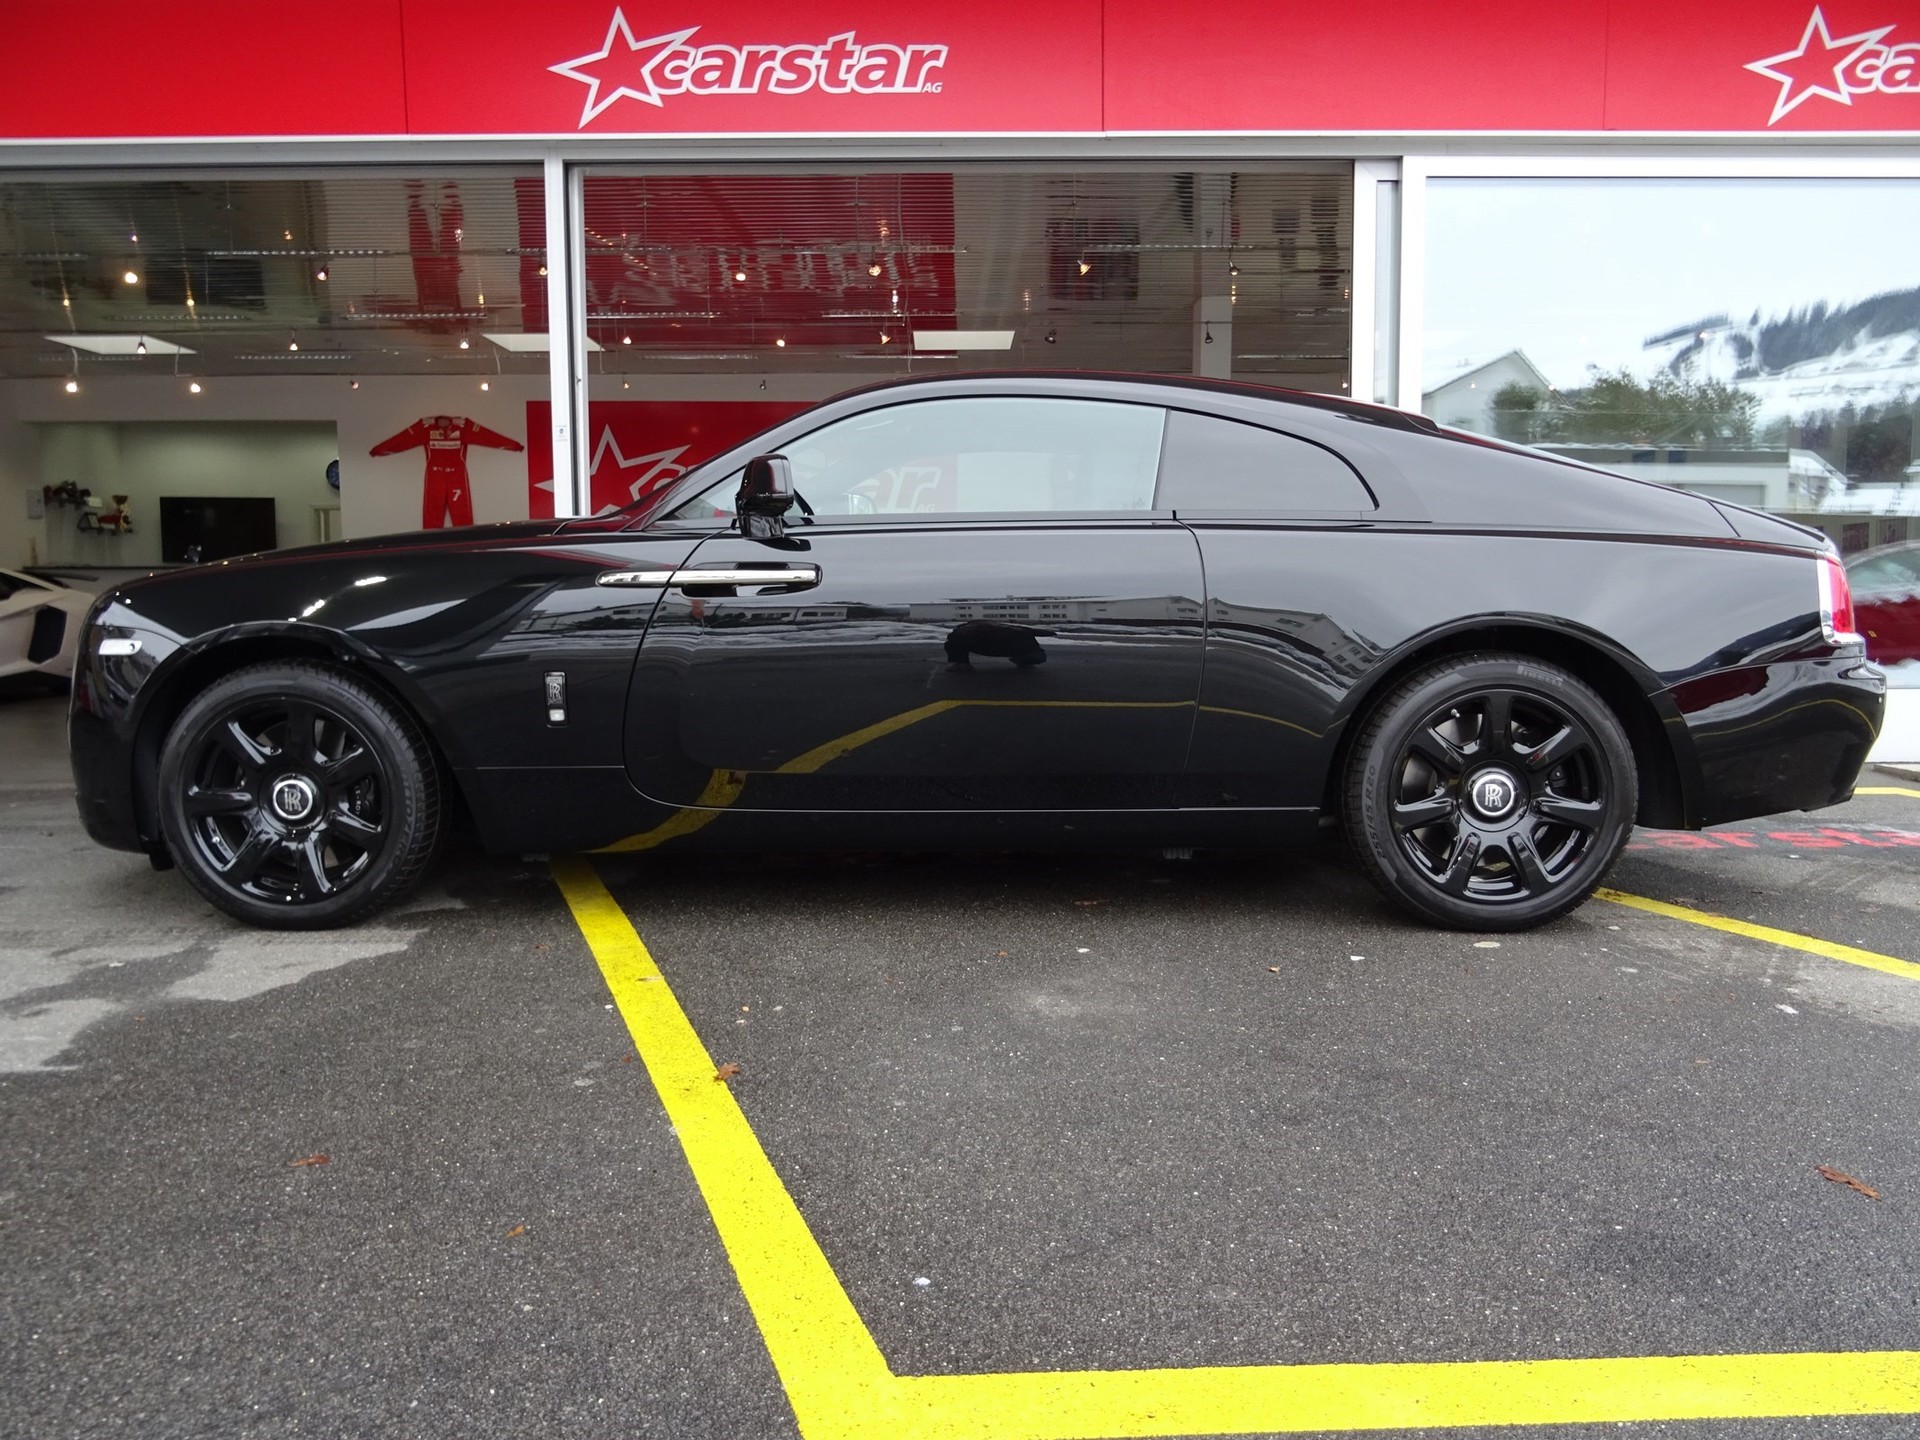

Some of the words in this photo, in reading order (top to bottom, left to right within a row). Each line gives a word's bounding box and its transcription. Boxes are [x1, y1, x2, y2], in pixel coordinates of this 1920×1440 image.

[648, 31, 949, 95] carstar
[922, 83, 943, 94] AG
[451, 488, 463, 502] 7
[1484, 783, 1503, 808] RR
